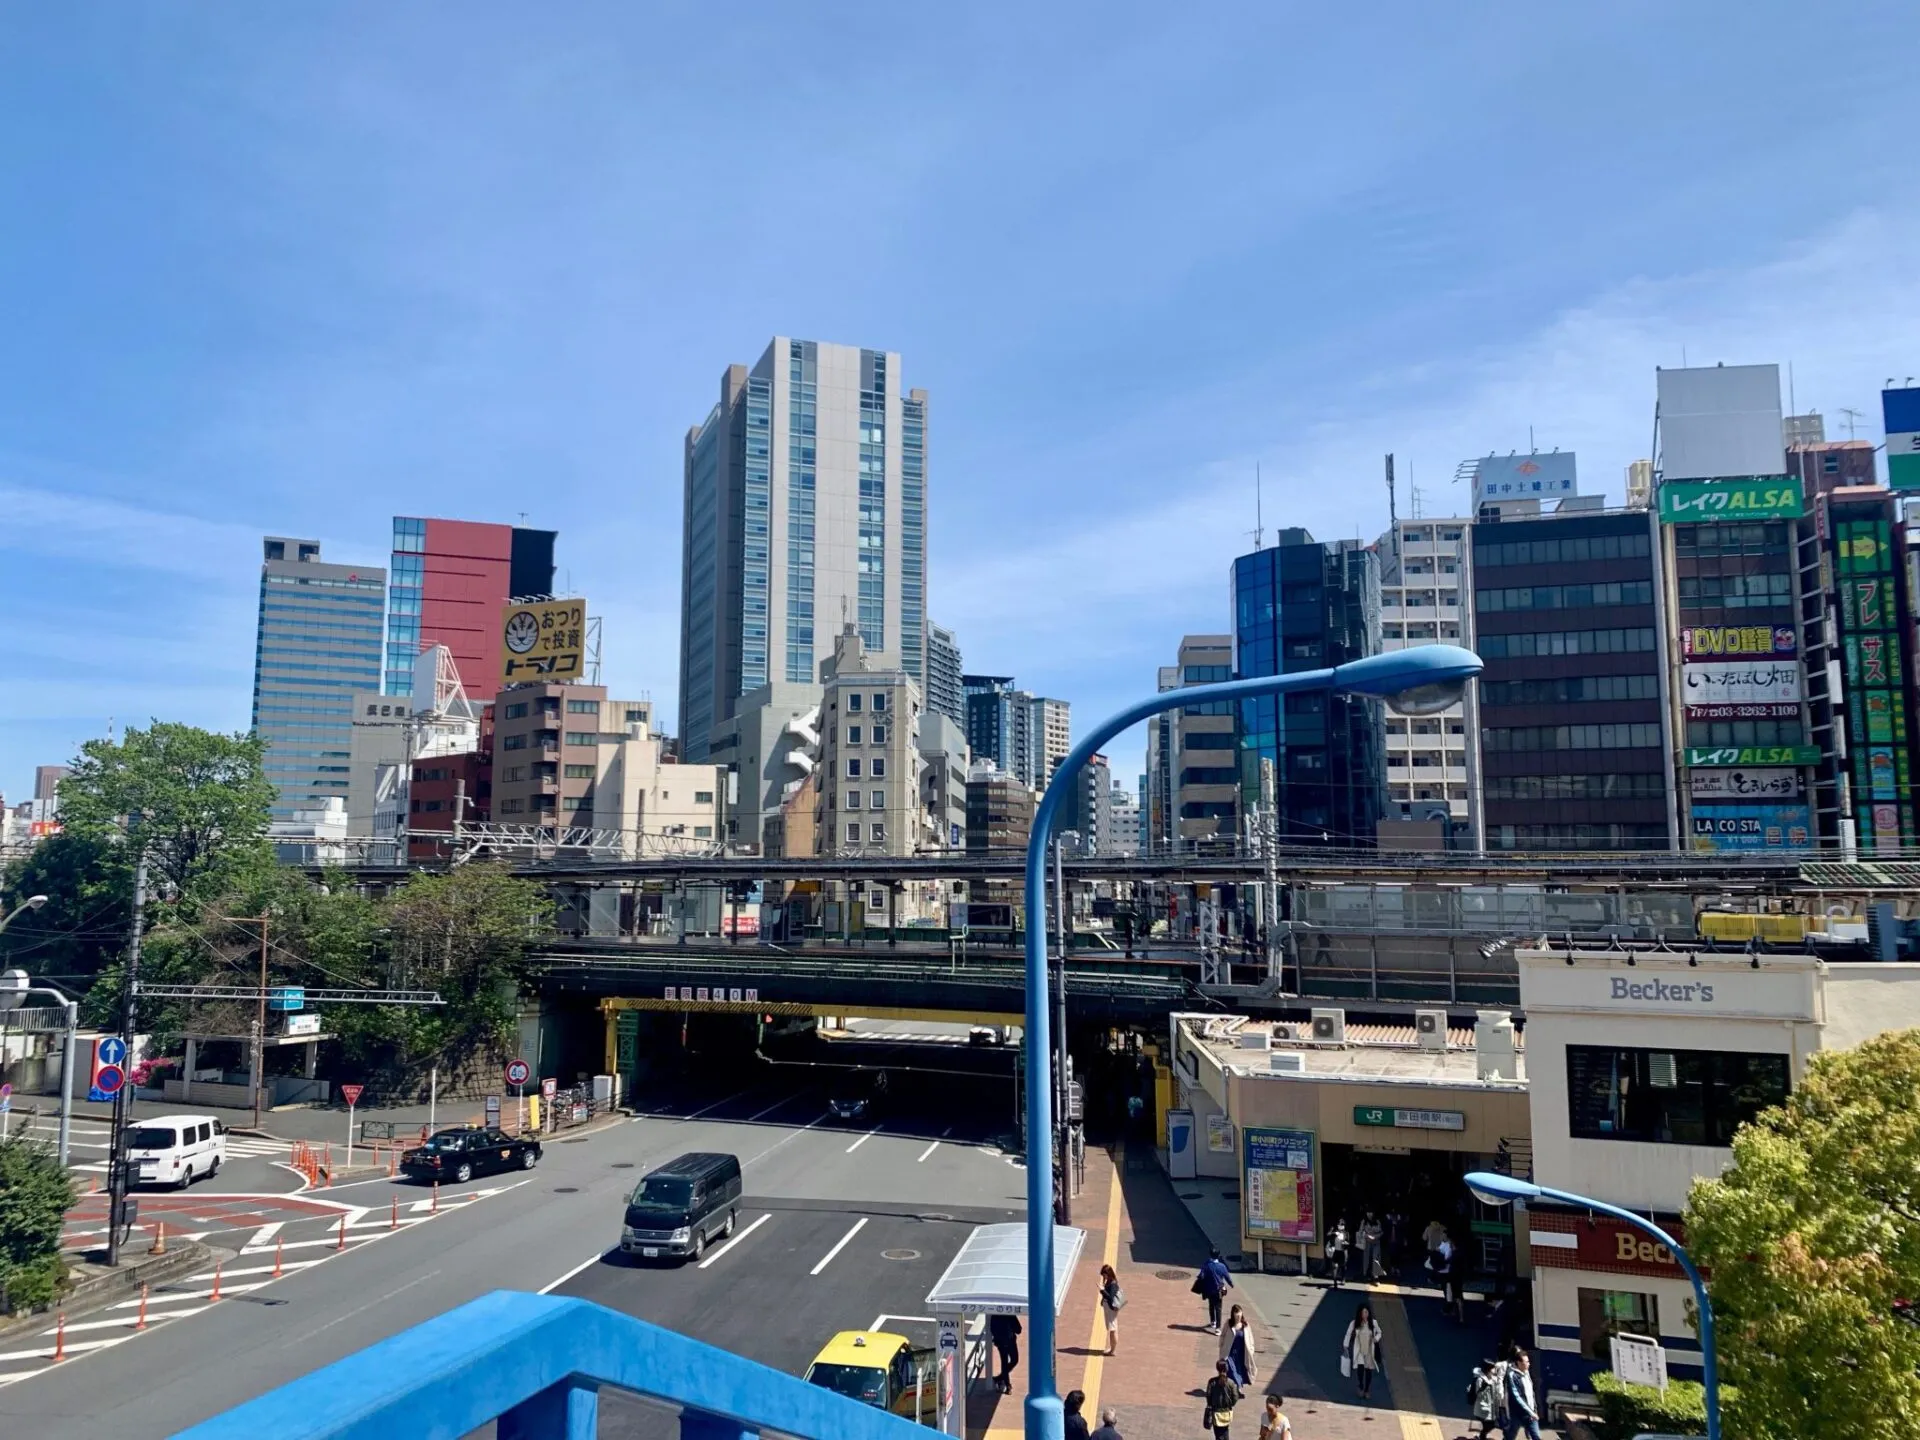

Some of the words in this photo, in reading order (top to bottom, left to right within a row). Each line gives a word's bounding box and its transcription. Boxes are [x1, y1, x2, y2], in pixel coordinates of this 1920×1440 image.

[1672, 489, 1796, 512] レイクALSA
[541, 607, 581, 629] おつり
[541, 629, 580, 650] で投資
[1694, 627, 1774, 653] DVD鑑賞
[505, 654, 579, 676] トラノコ
[1692, 748, 1795, 764] レイクALSA
[1696, 820, 1713, 832] LA
[1719, 820, 1736, 832] CO
[1740, 820, 1762, 832] STA
[1610, 976, 1714, 1002] Becker's
[1366, 1110, 1383, 1120] JR
[961, 1303, 1022, 1313] タクシーのりば
[939, 1320, 960, 1329] TAXI
